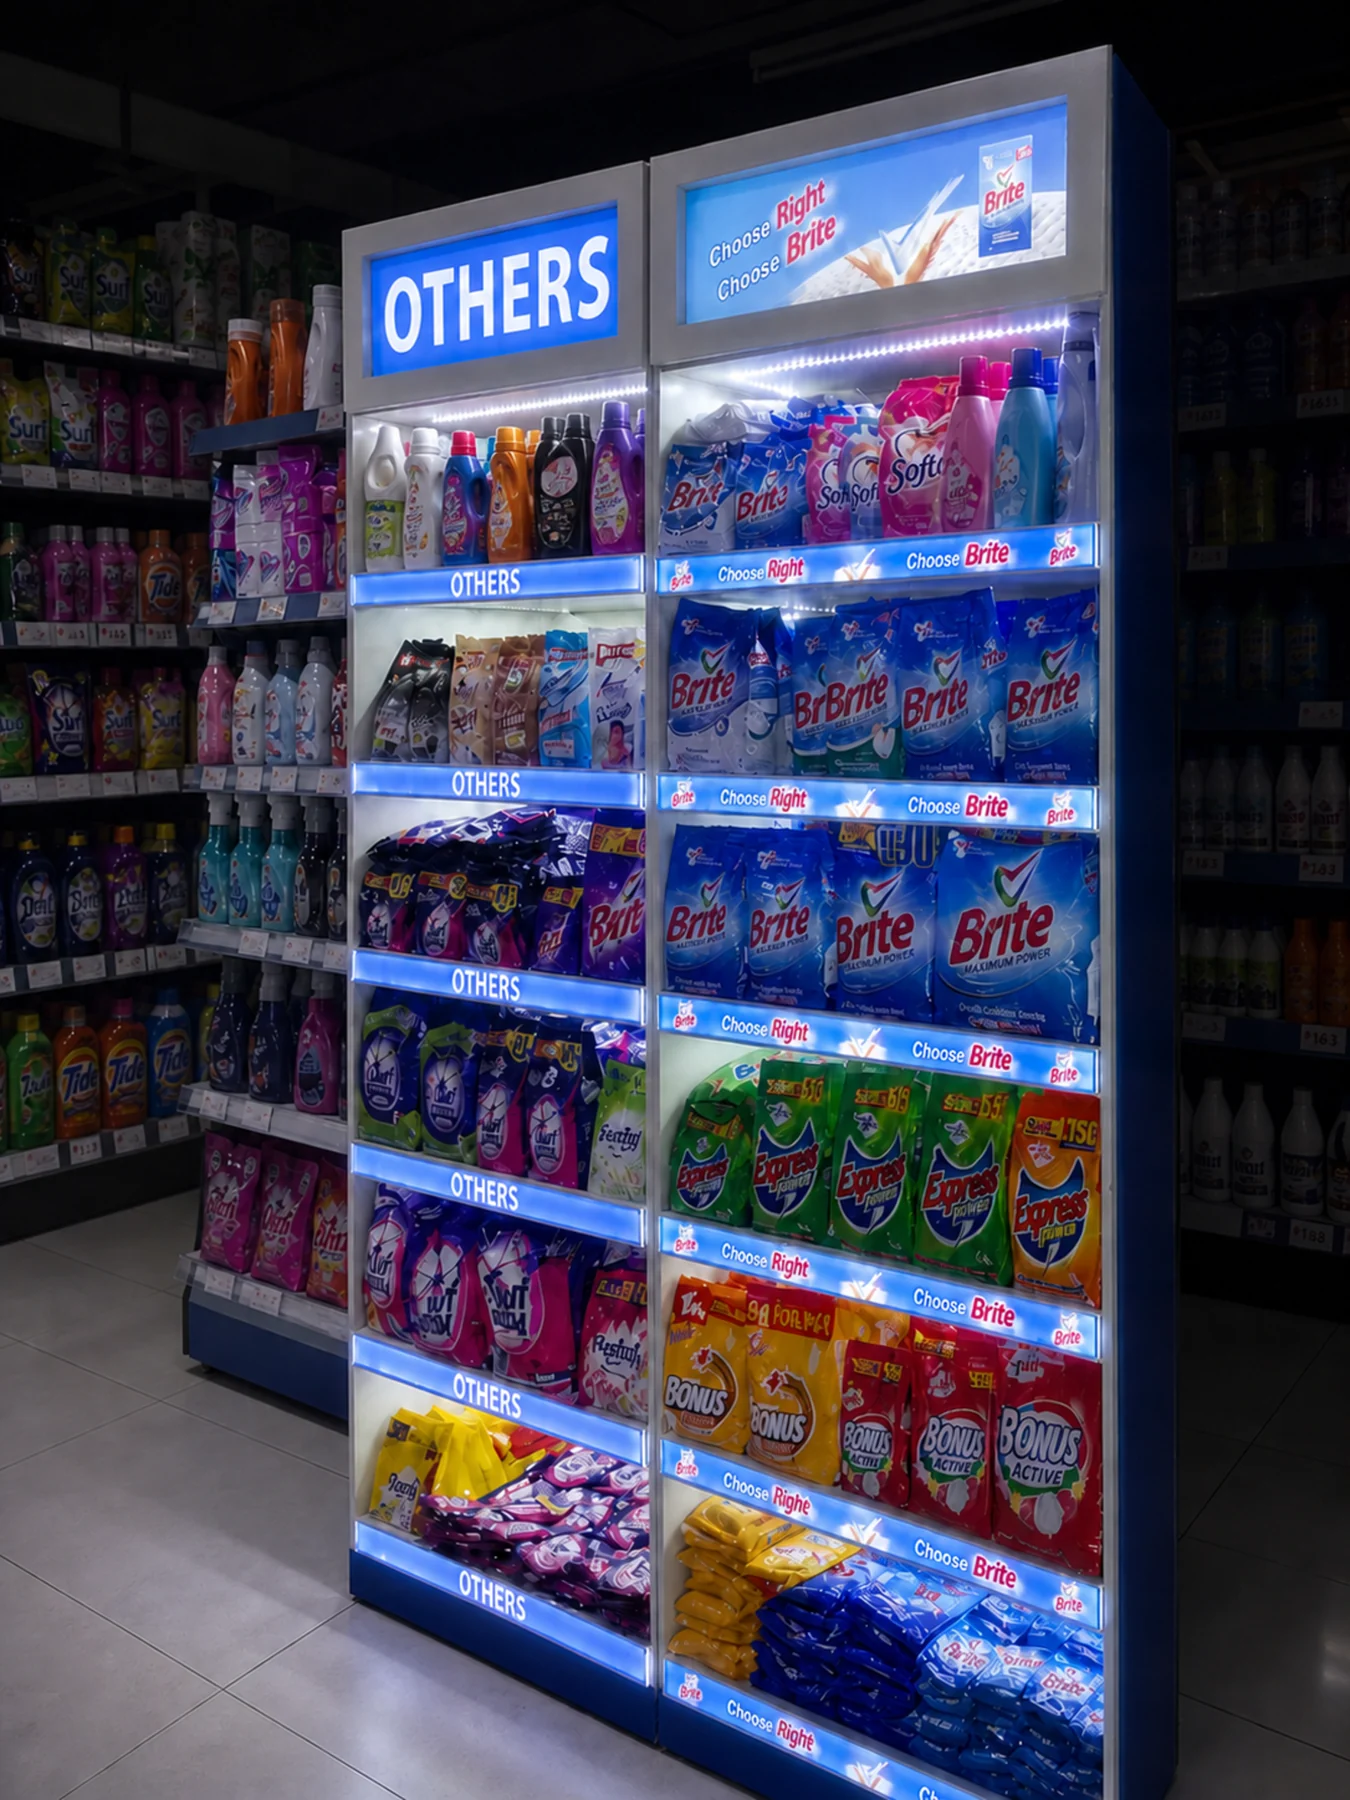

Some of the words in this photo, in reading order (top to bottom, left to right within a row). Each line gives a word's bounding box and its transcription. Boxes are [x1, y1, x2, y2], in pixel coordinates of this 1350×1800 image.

[984, 181, 1025, 216] Brite
[709, 221, 771, 268] Choose
[775, 179, 826, 231] Right
[717, 255, 780, 301] Choose
[786, 216, 837, 266] Brite
[384, 235, 611, 354] OTHERS
[736, 485, 788, 521] Brite
[718, 566, 764, 582] Choose
[767, 557, 805, 583] Right
[906, 552, 960, 570] Choose
[964, 540, 1010, 567] Brite
[1049, 545, 1077, 565] Brite
[450, 568, 521, 598] OTHERS
[671, 667, 736, 710] Brite
[825, 672, 889, 723] Brite
[903, 678, 969, 731] Brite
[1007, 672, 1081, 723] Brite
[450, 770, 521, 798] OTHERS
[720, 788, 767, 806] Choose
[770, 787, 807, 812] Right
[908, 796, 961, 815] Choose
[965, 794, 1009, 818] Brite
[1047, 807, 1074, 826] Brite
[666, 903, 727, 942] Brite
[750, 905, 810, 949] Brite
[836, 909, 915, 964] Brite
[949, 901, 1054, 967] Brite
[964, 956, 1014, 974] MAXIMUM
[1015, 948, 1051, 967] POWER
[451, 968, 521, 1002] OTHERS
[721, 1014, 768, 1037] Choose
[771, 1018, 809, 1044] Right
[108, 1055, 144, 1093] Tide
[912, 1040, 965, 1064] Choose
[968, 1043, 1013, 1071] Brite
[63, 1064, 97, 1102] Tide
[1050, 1067, 1078, 1084] Brite
[753, 1142, 819, 1193] Express
[835, 1152, 907, 1206] Express
[450, 1172, 519, 1212] OTHERS
[921, 1164, 1000, 1218] Express
[1013, 1188, 1090, 1242] Express
[721, 1242, 768, 1268] Choose
[771, 1252, 810, 1280] Right
[913, 1288, 966, 1315] Choose
[970, 1296, 1015, 1328] Brite
[1054, 1330, 1081, 1346] Brite
[453, 1373, 522, 1420] OTHERS
[664, 1374, 729, 1417] BONUS
[752, 1404, 807, 1444] BONUS
[843, 1420, 892, 1455] BONUS
[924, 1415, 985, 1460] BONUS
[999, 1405, 1082, 1467] BONUS
[933, 1457, 972, 1474] ACTIVE
[1011, 1462, 1064, 1486] ACTIVE
[723, 1472, 769, 1501] Choose
[914, 1538, 968, 1571] Choose
[972, 1555, 1017, 1589] Brite
[459, 1570, 527, 1622] OTHERS
[1055, 1597, 1083, 1613] Brite
[727, 1699, 773, 1733] Choose
[777, 1719, 815, 1751] Right
